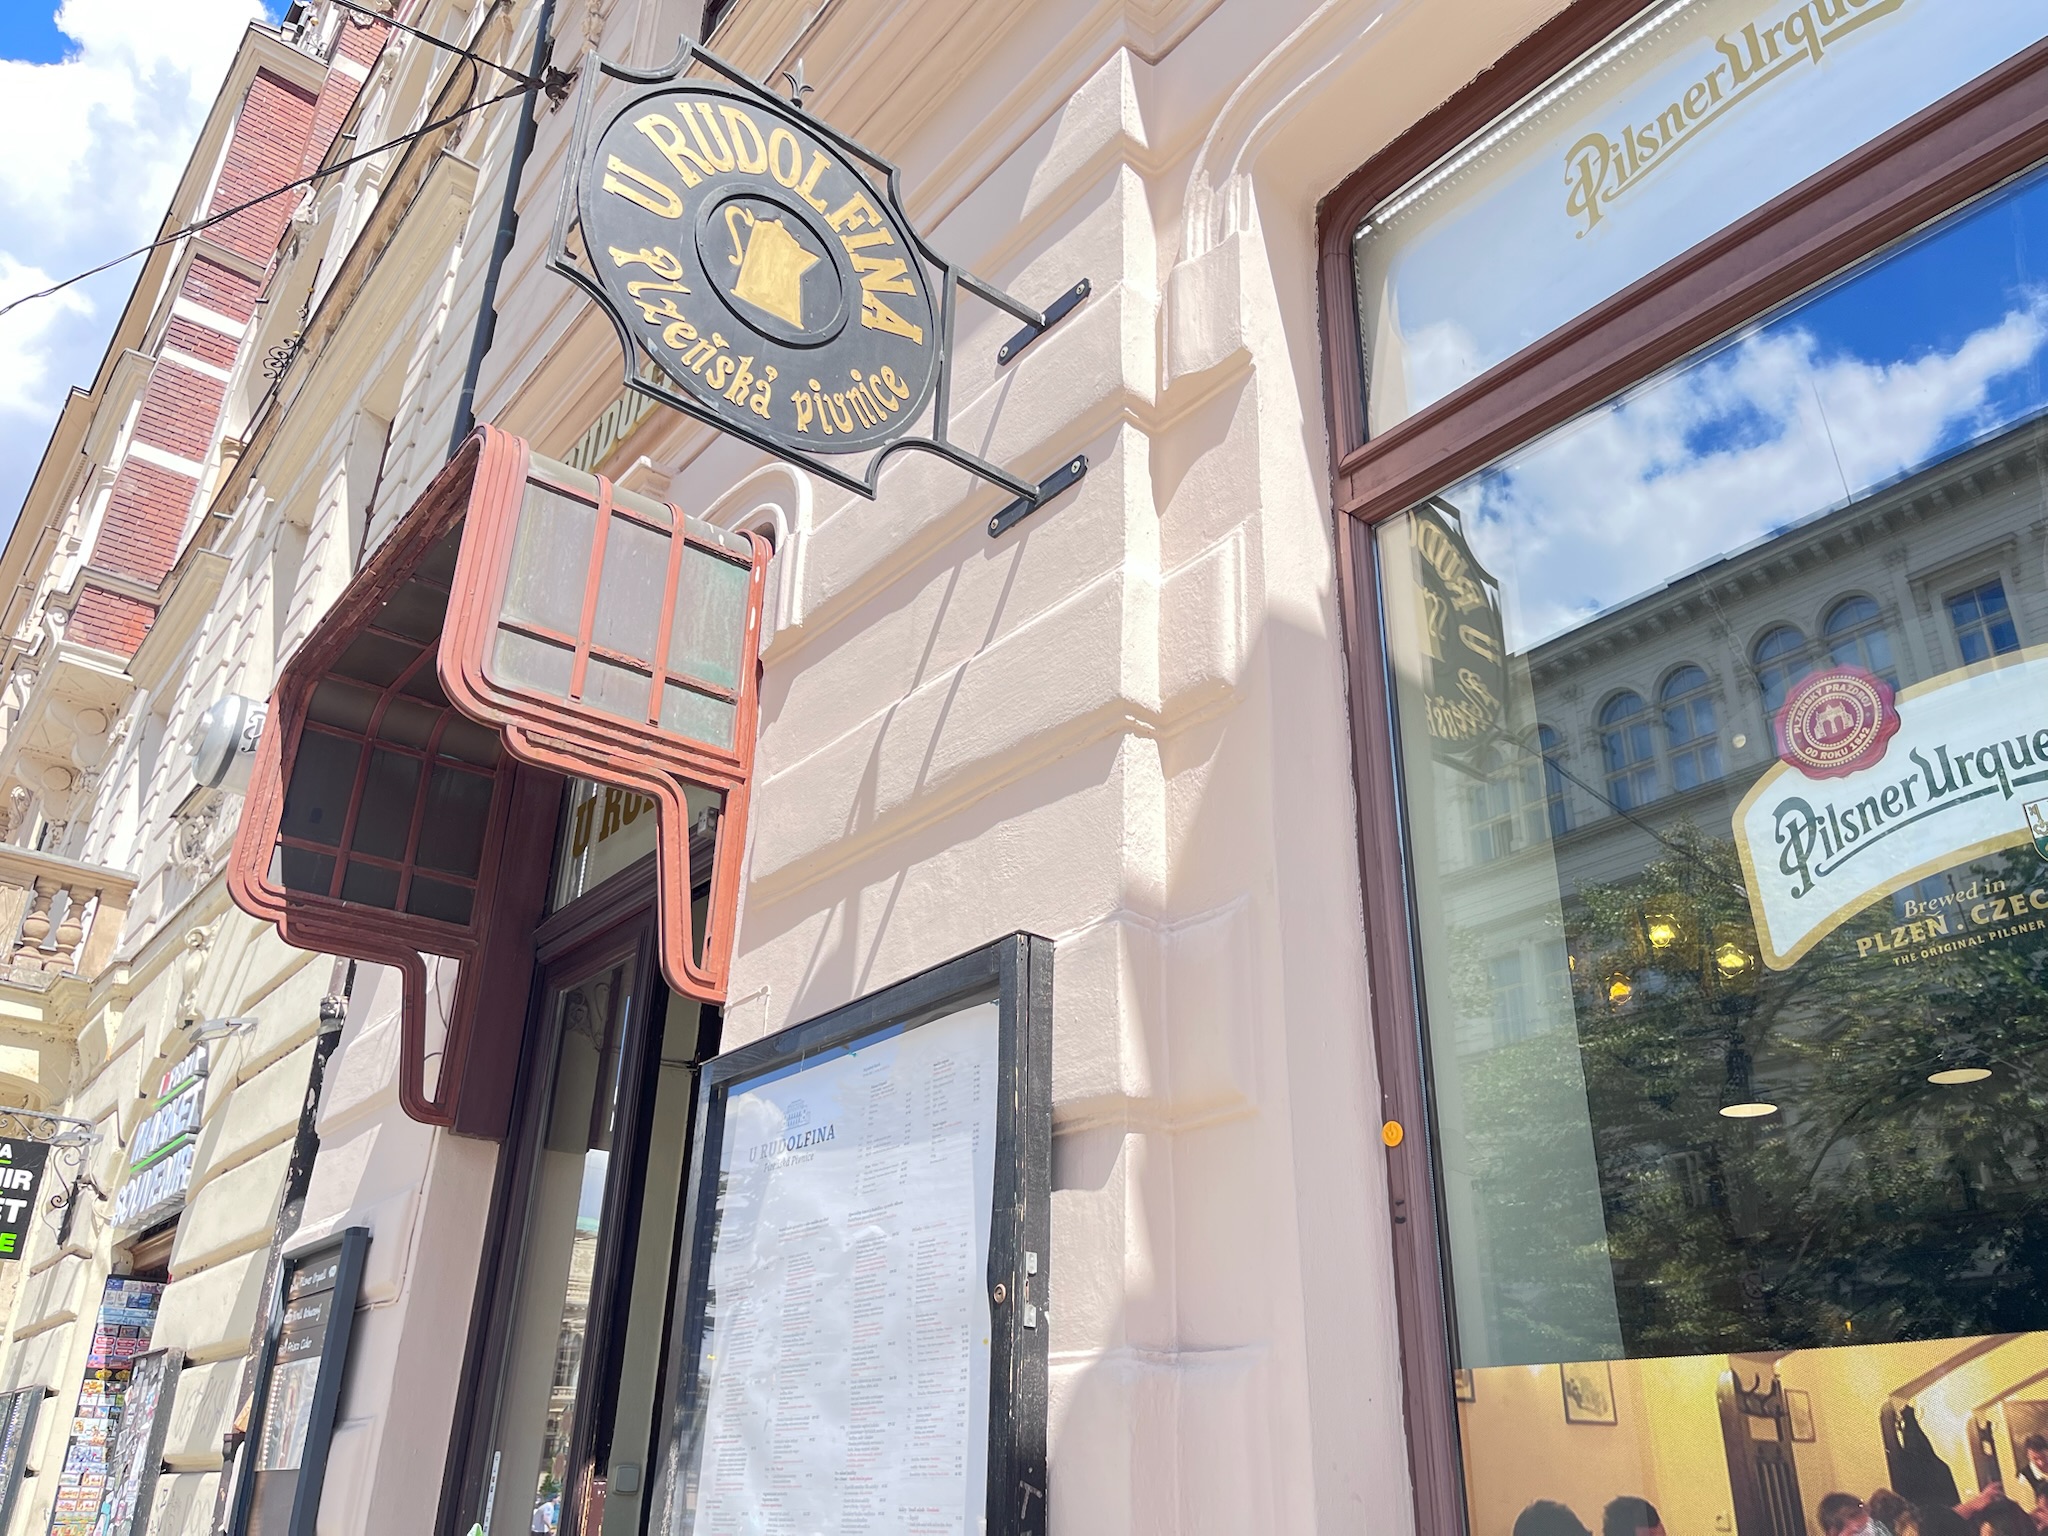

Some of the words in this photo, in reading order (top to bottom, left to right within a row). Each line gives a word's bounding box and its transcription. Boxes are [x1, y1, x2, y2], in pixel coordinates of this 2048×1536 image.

[1564, 62, 1727, 239] Pilsner
[1715, 0, 1869, 89] Urqu
[602, 153, 683, 220] U
[633, 101, 922, 346] RUDOLFINA
[790, 365, 911, 435] pivnice
[1825, 683, 1872, 707] PRAZDROJ
[1805, 746, 1818, 758] OD
[1820, 747, 1848, 759] ROKU
[1849, 726, 1870, 750] 1842
[1772, 773, 1918, 899] Pilsner
[1904, 882, 1978, 918] Brewed
[1985, 878, 2006, 895] in
[1893, 954, 1918, 967] THE
[1921, 935, 1985, 959] ORIGINAL
[1989, 919, 2046, 942] PILSNER
[749, 1146, 758, 1163] U
[760, 1124, 835, 1160] RUDOLFINA
